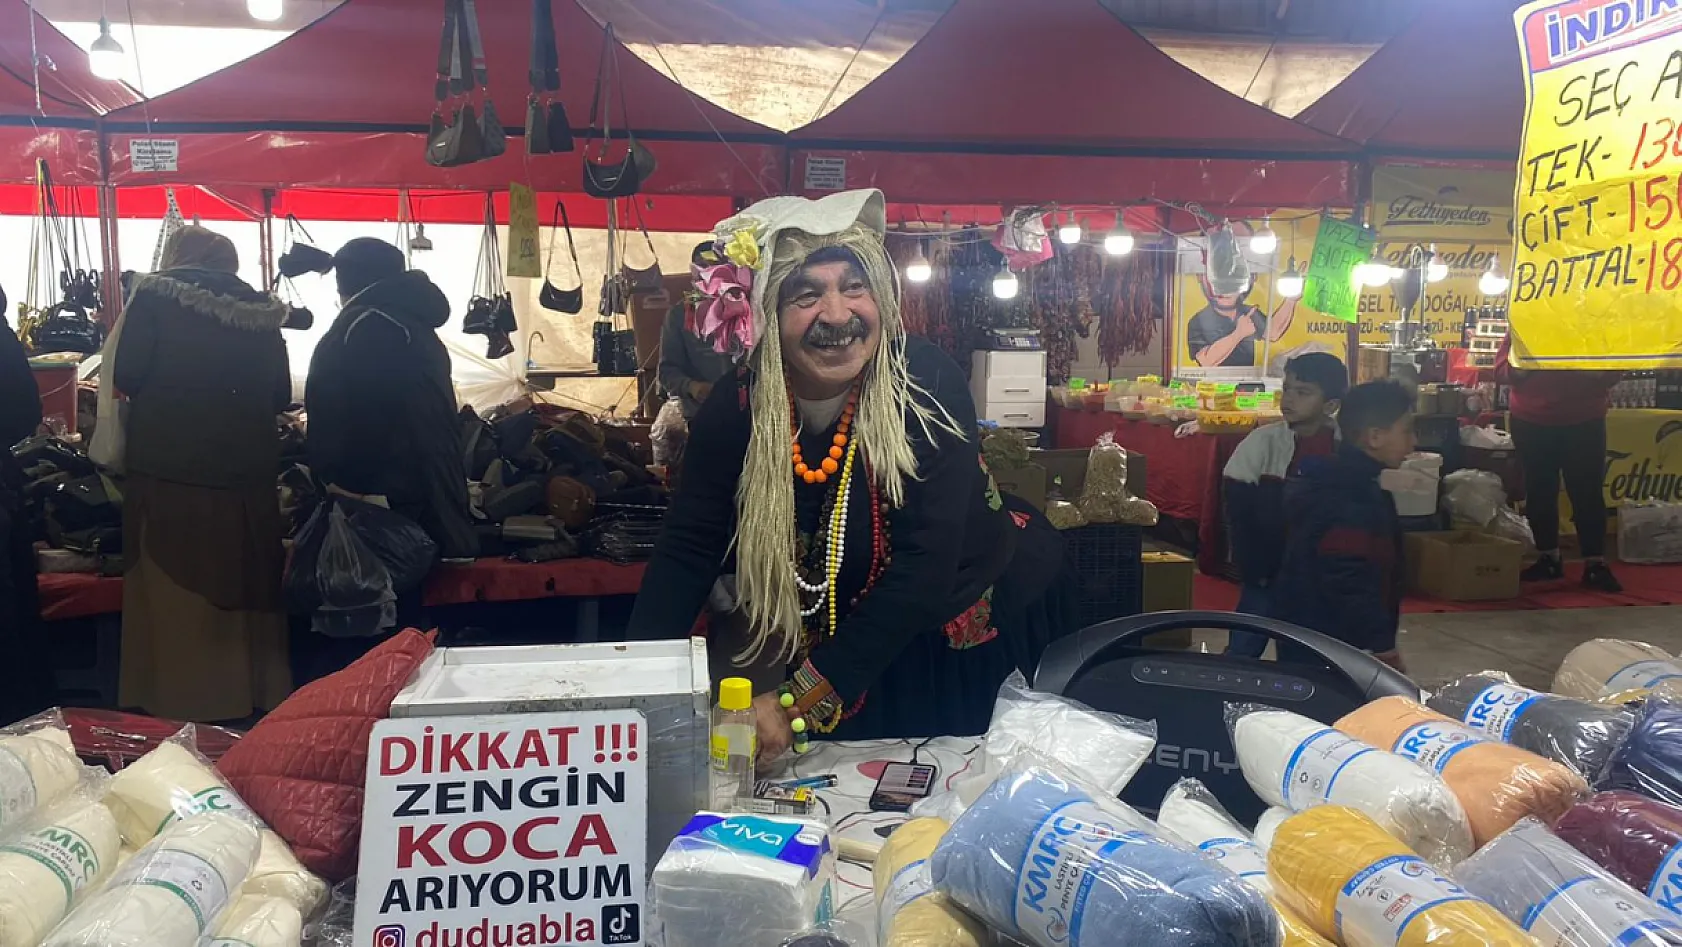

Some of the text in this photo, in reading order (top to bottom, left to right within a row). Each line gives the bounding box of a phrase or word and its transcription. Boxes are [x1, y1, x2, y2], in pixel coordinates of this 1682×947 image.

[1554, 61, 1639, 127] SEÇ
[1323, 219, 1369, 250] TAZE
[1387, 194, 1491, 224] Fethiyeden
[1307, 322, 1348, 335] KARADU
[379, 725, 579, 776] DİKKAT
[392, 766, 626, 817] ZENGİN
[397, 813, 618, 869] KOCA
[720, 819, 784, 847] viva
[379, 863, 632, 914] ARIYORUM
[1022, 815, 1083, 914] KMRC
[415, 911, 596, 947] duduabla
